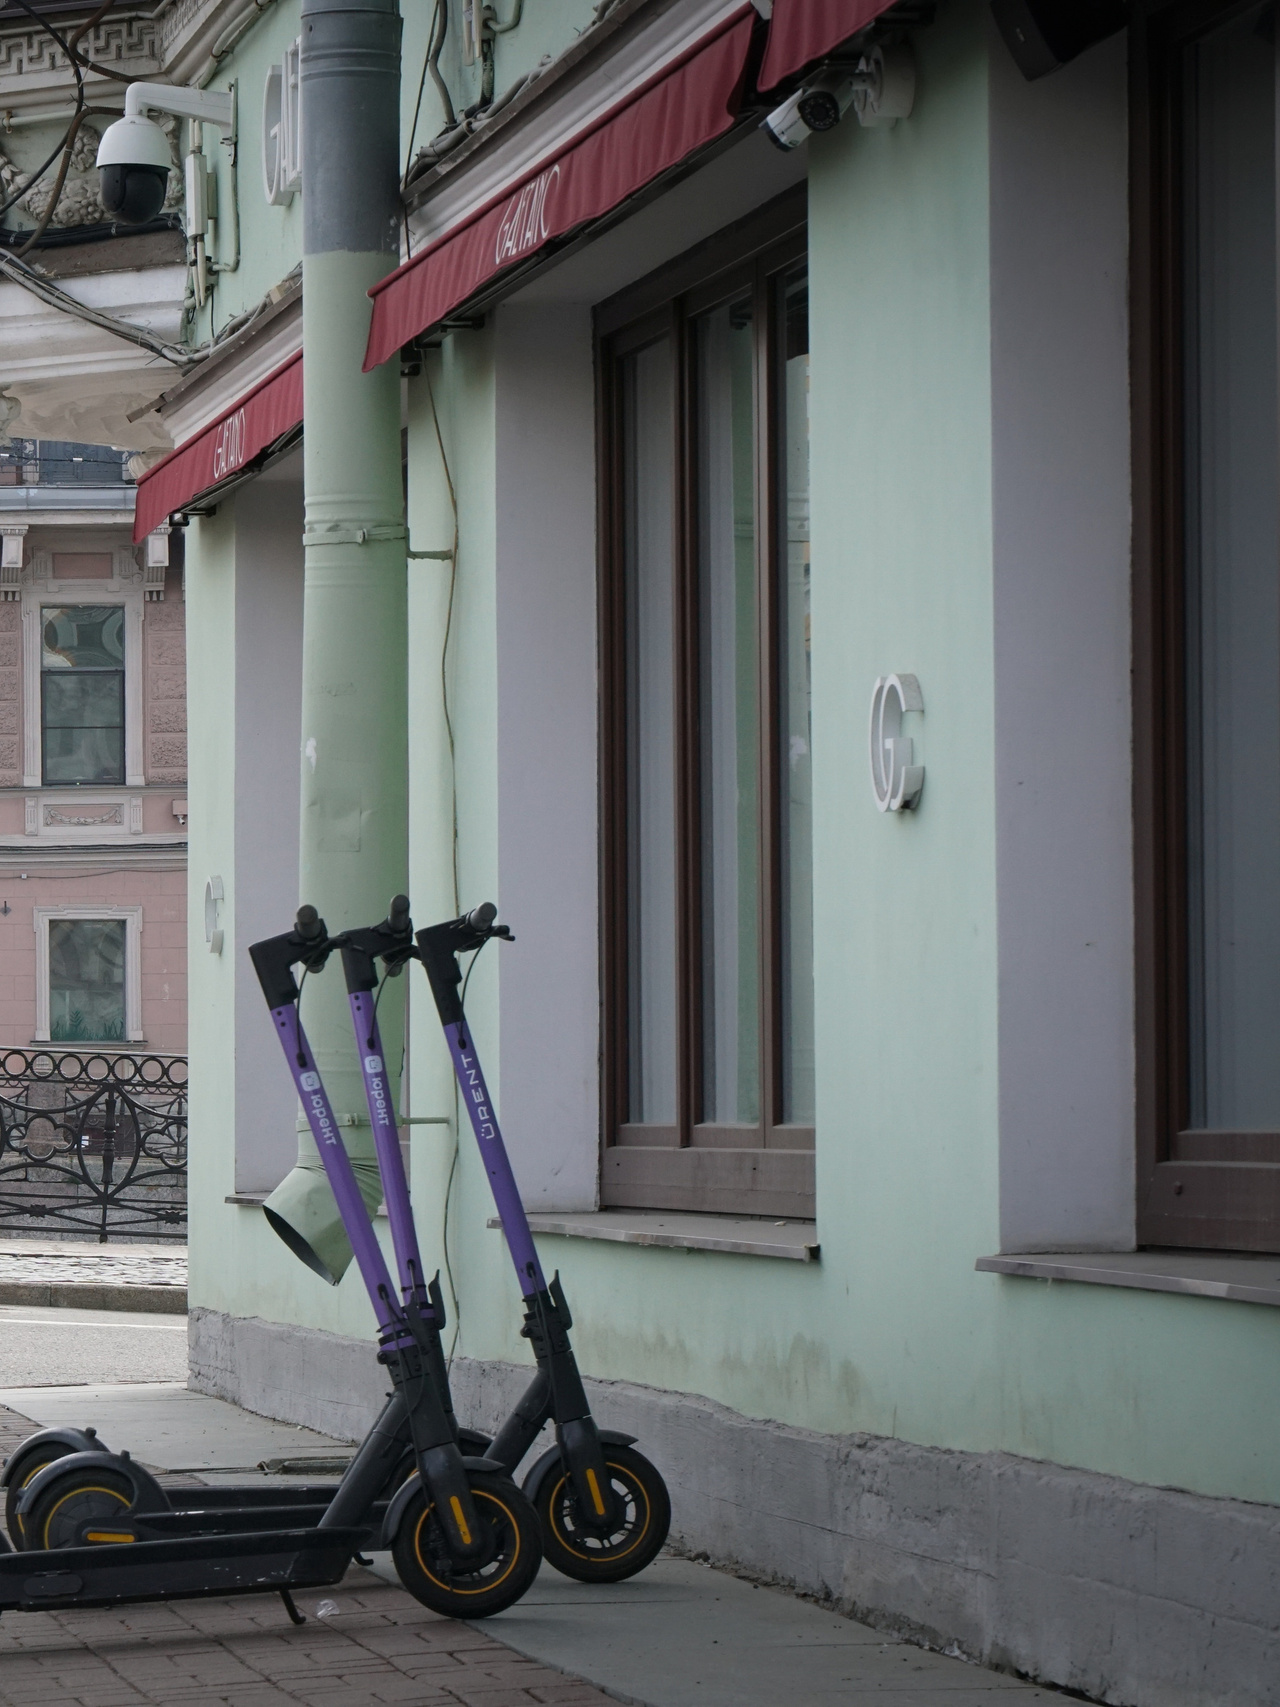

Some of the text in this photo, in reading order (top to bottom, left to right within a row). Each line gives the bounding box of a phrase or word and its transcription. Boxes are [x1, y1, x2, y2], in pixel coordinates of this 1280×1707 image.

[310, 1094, 337, 1145] юрент
[371, 1077, 390, 1126] юрент
[460, 1054, 496, 1139] ÜRENT
